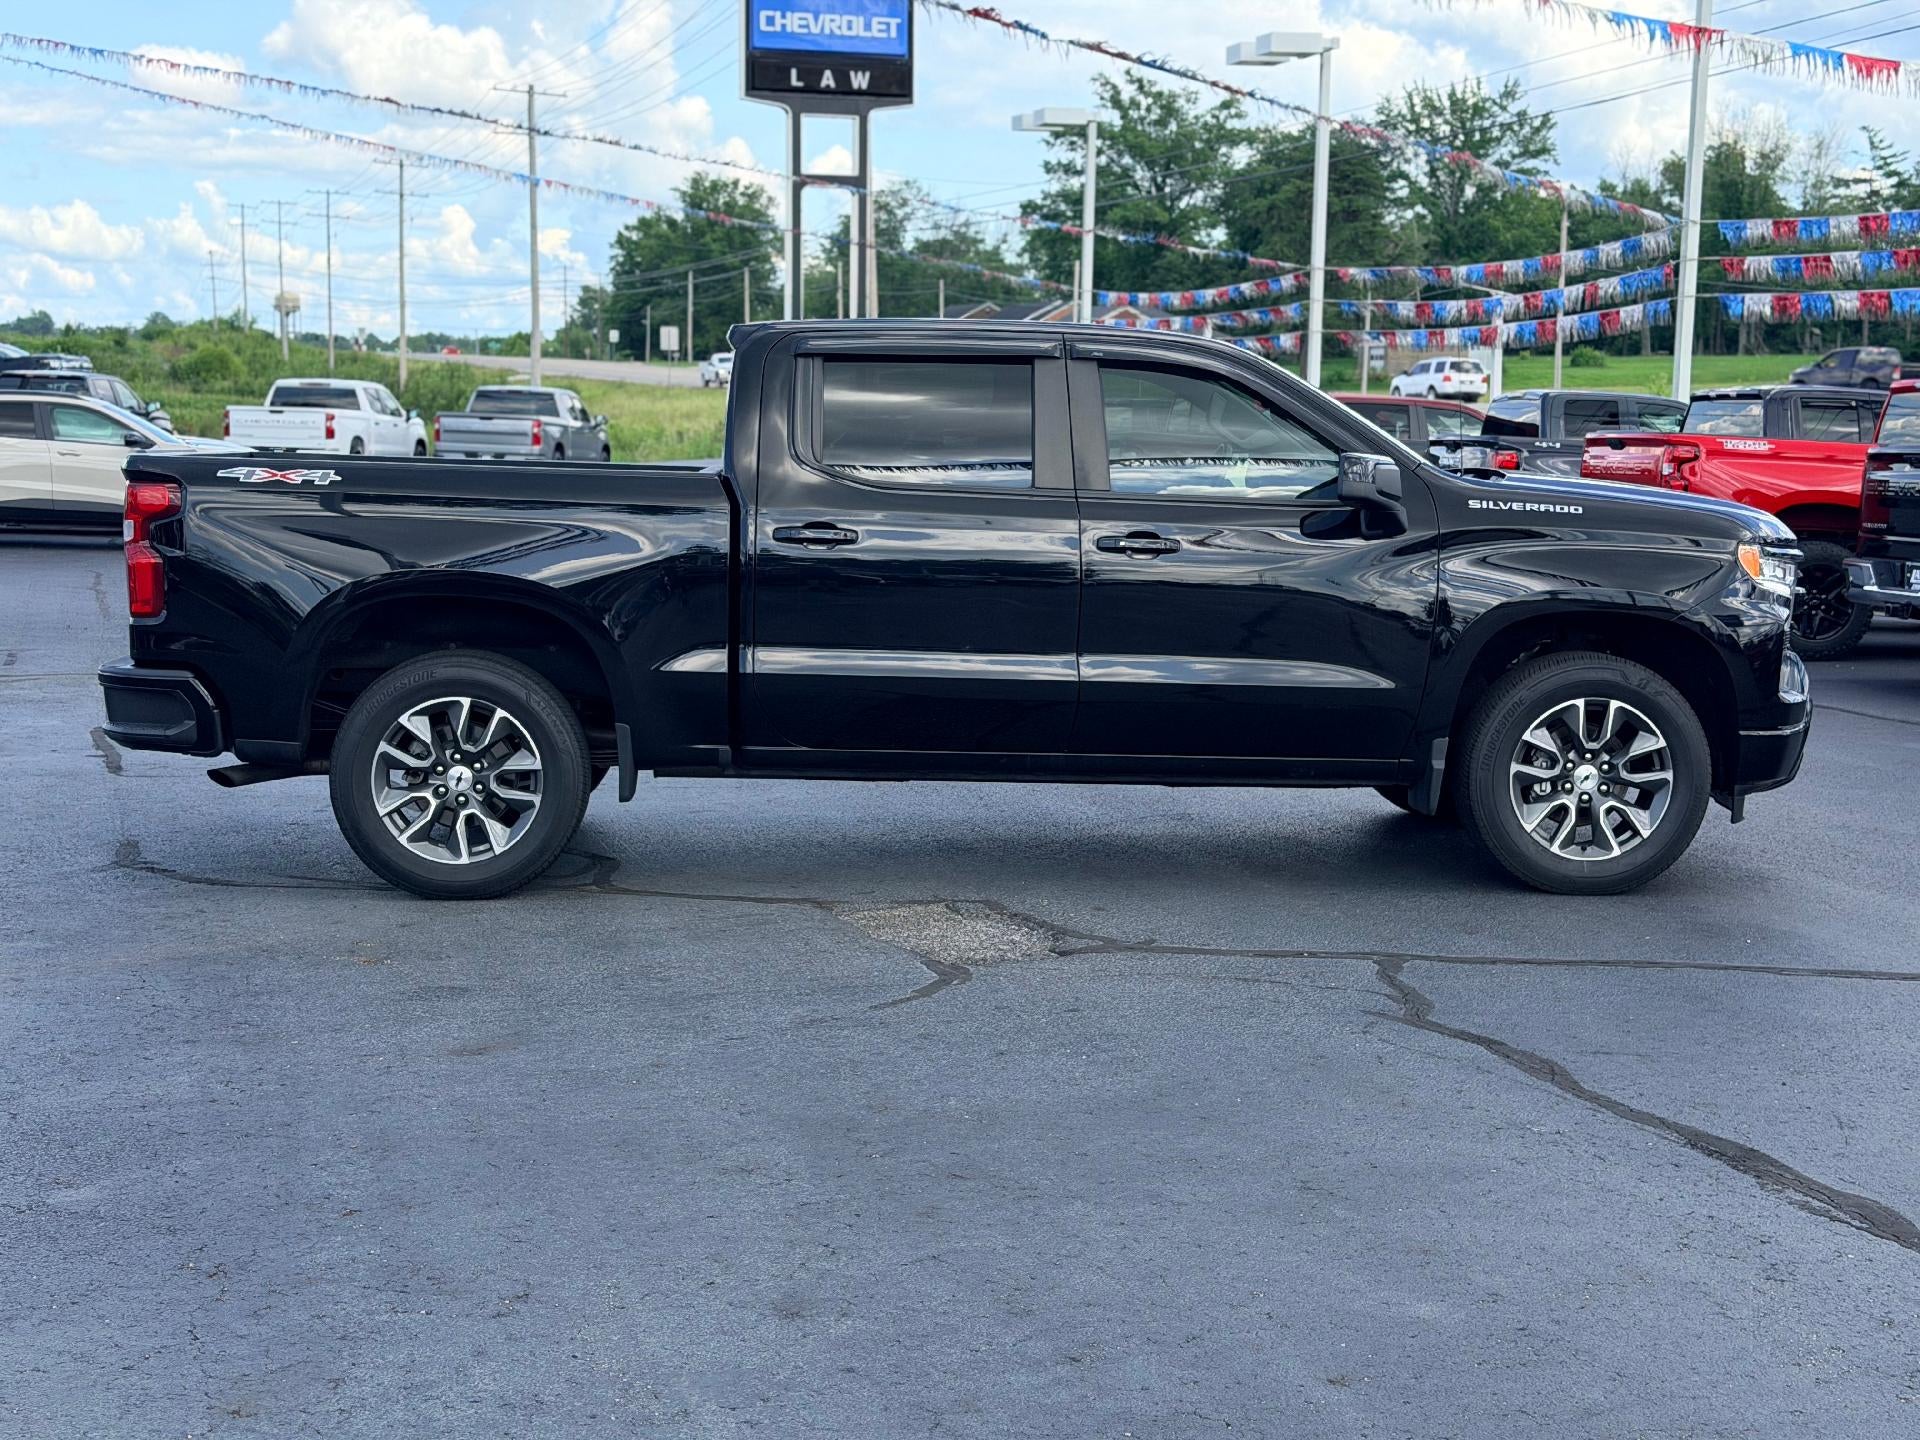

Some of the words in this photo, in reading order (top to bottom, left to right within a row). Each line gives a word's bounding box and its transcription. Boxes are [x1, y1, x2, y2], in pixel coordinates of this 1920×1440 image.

[759, 10, 902, 38] CHEVROLET
[790, 68, 871, 90] LAW
[1468, 500, 1583, 514] SILVERADO
